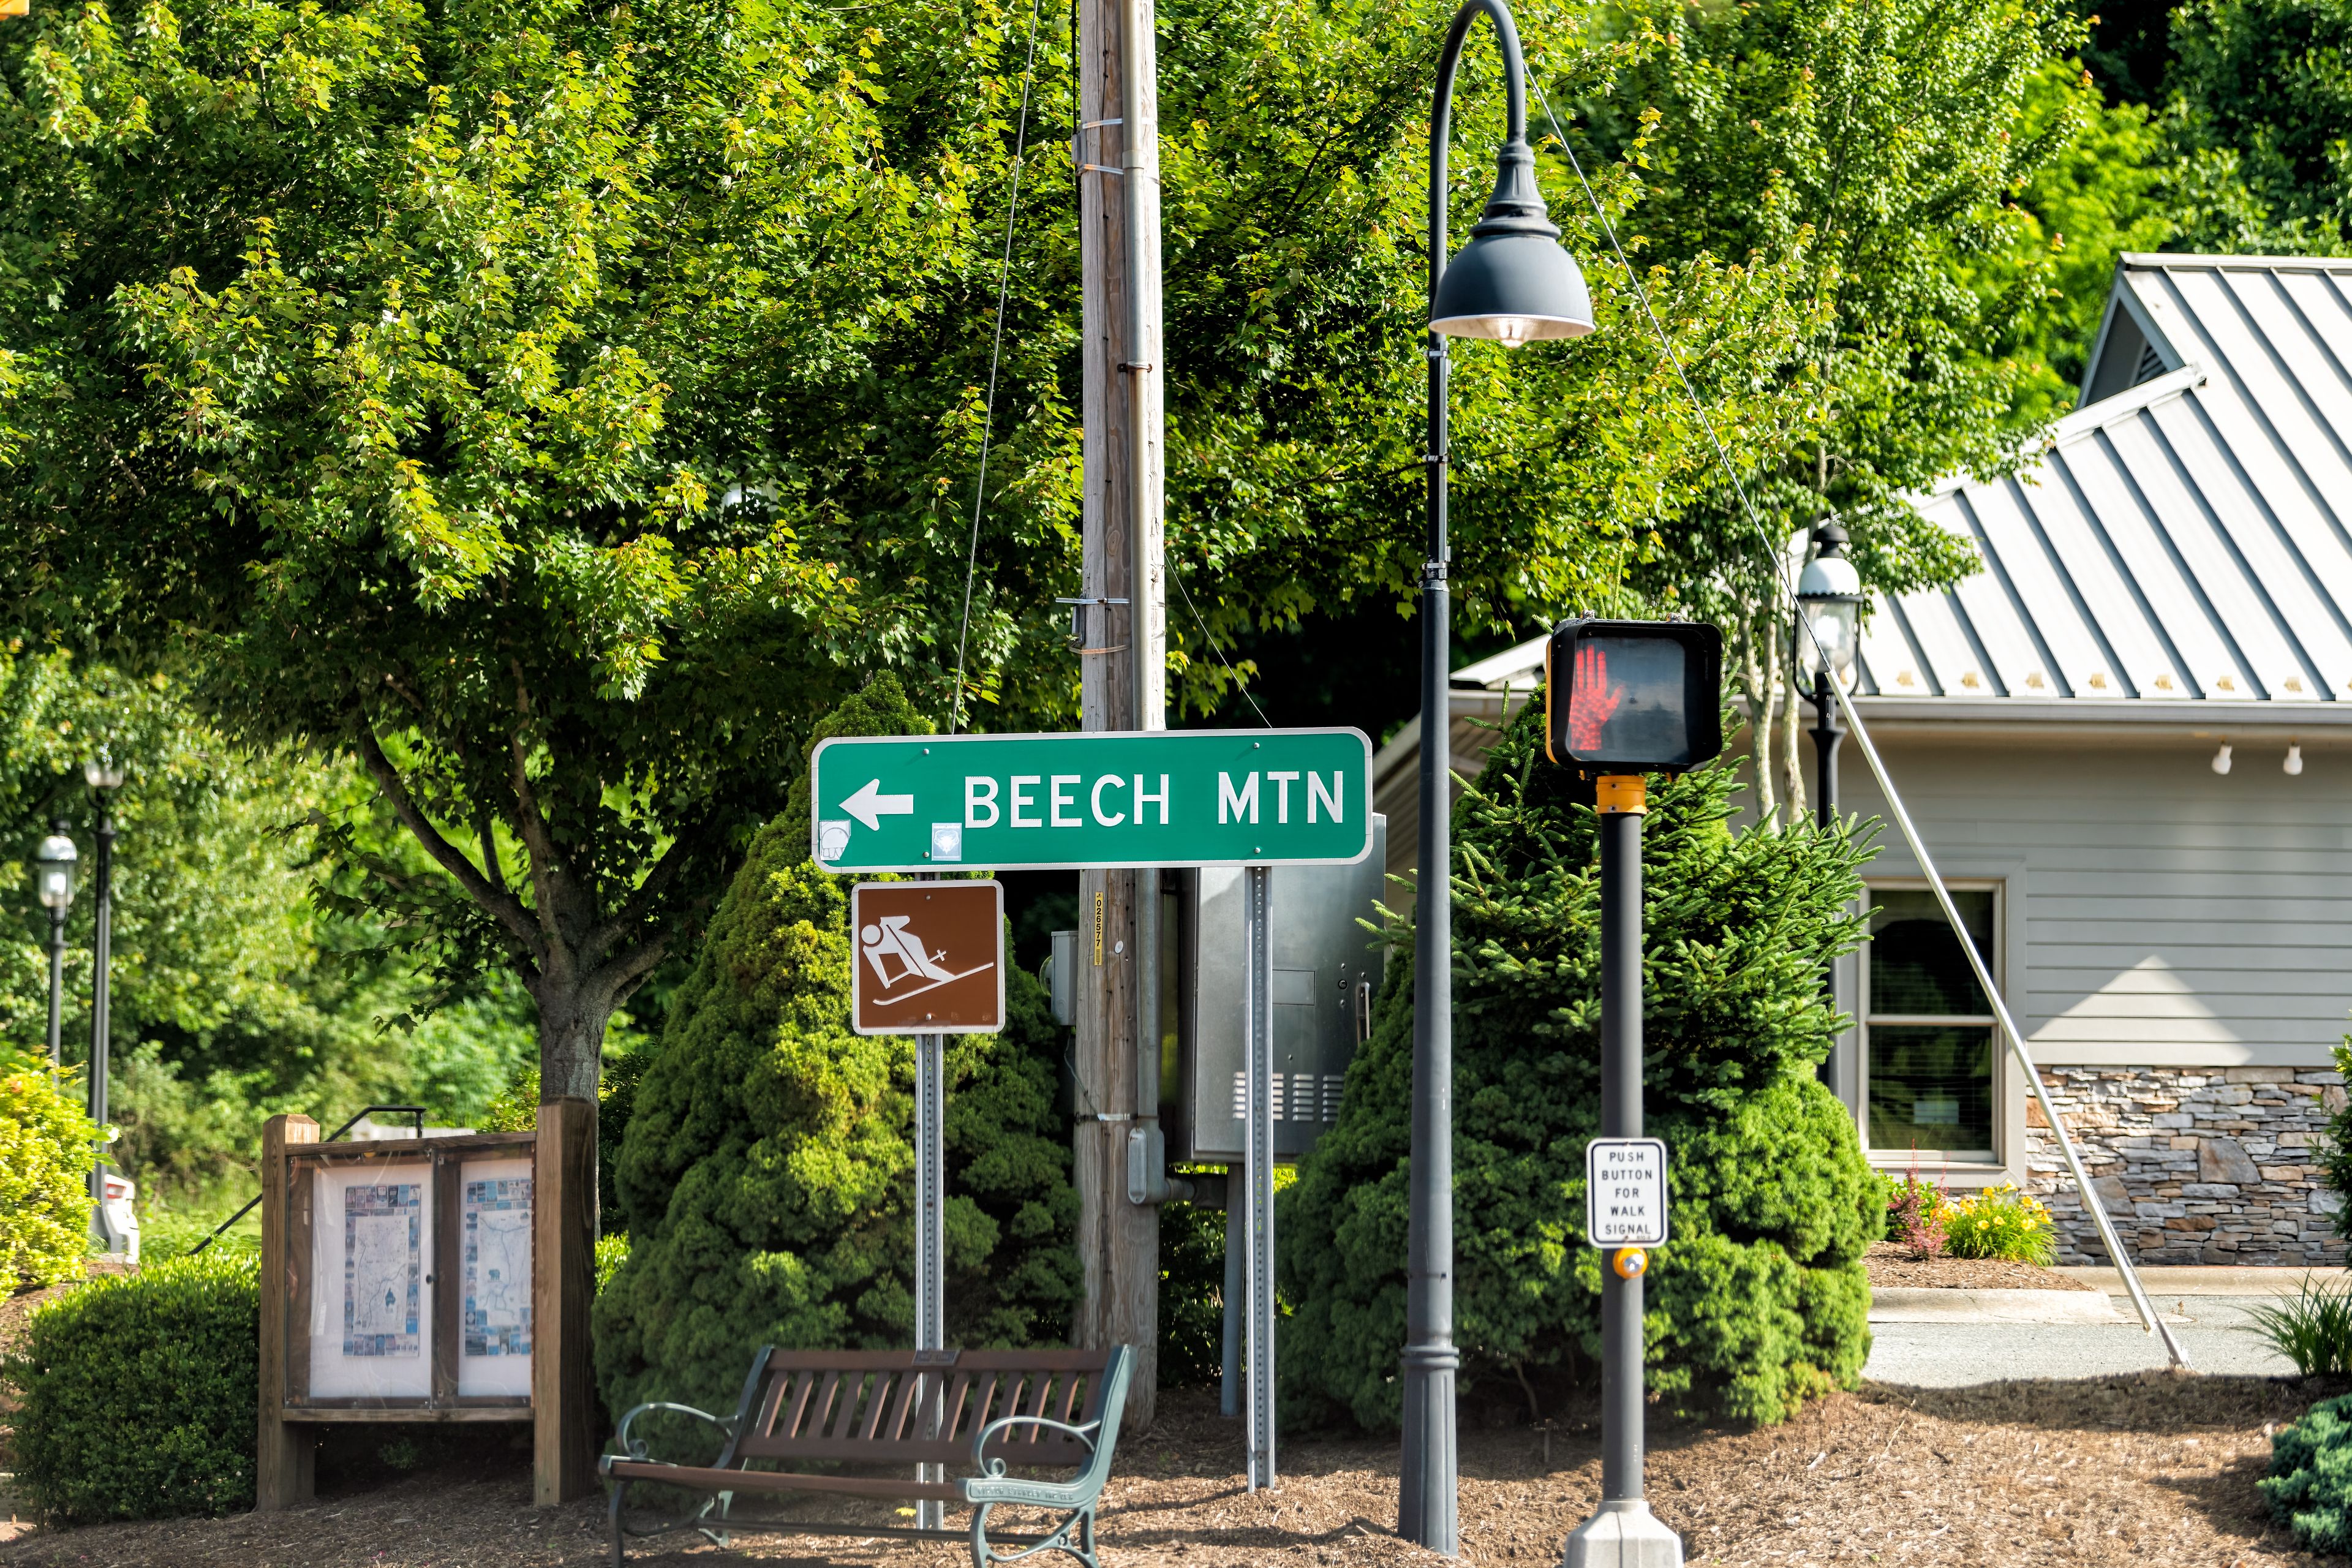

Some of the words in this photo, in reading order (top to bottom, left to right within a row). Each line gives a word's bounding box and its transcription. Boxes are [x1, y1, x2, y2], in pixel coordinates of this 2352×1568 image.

[965, 774, 1169, 828] BEECH
[1218, 771, 1343, 824] MTN
[1609, 1152, 1644, 1162] PUSH
[1601, 1170, 1652, 1180] BUTTON
[1615, 1188, 1639, 1198] FOR
[1610, 1206, 1645, 1216] WALK
[1605, 1224, 1651, 1235] SIGNAL
